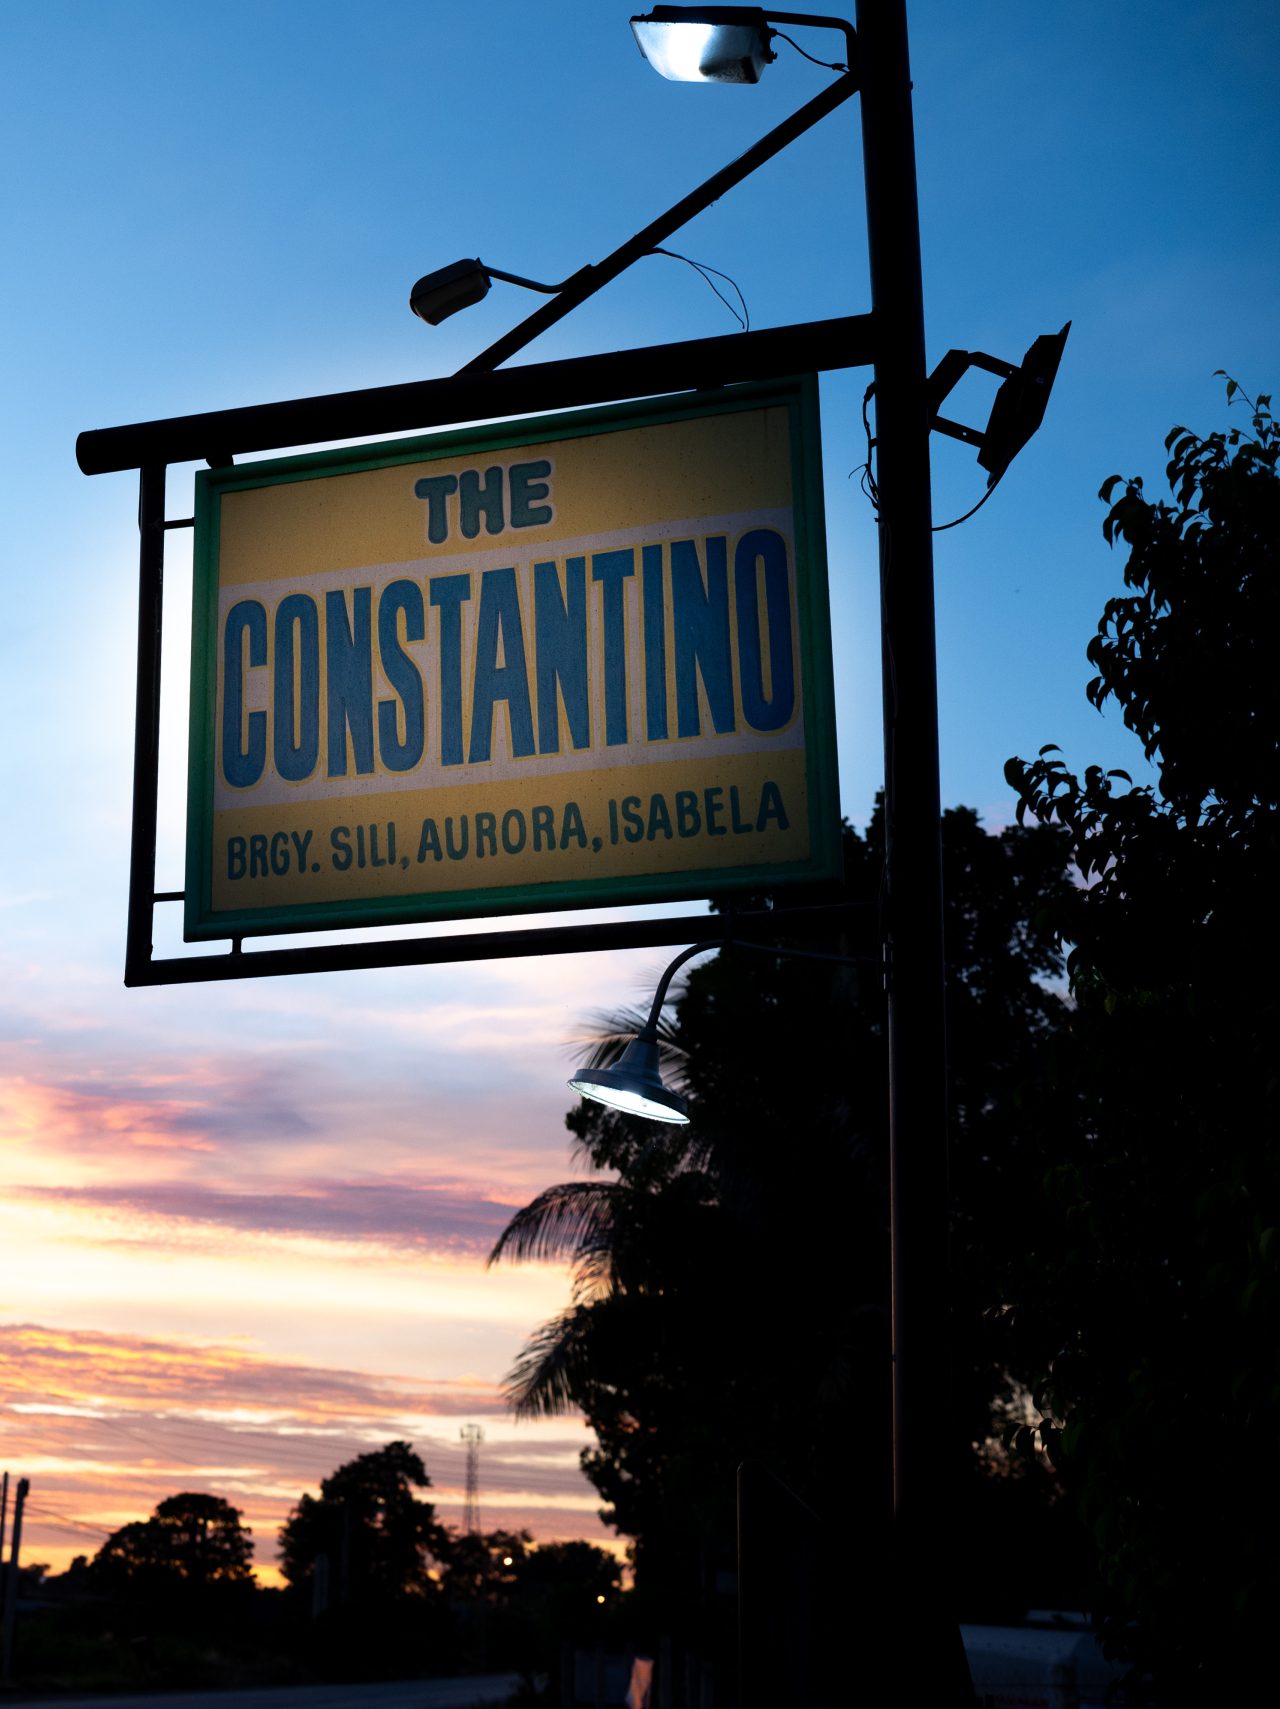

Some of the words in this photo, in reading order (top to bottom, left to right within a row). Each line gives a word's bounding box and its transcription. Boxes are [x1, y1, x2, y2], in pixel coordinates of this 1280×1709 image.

[415, 460, 553, 544] THE
[222, 529, 795, 788] CONSTANTINO
[227, 830, 320, 880] BRGY.
[331, 822, 410, 871] SILI,
[608, 781, 789, 844] ISABELA
